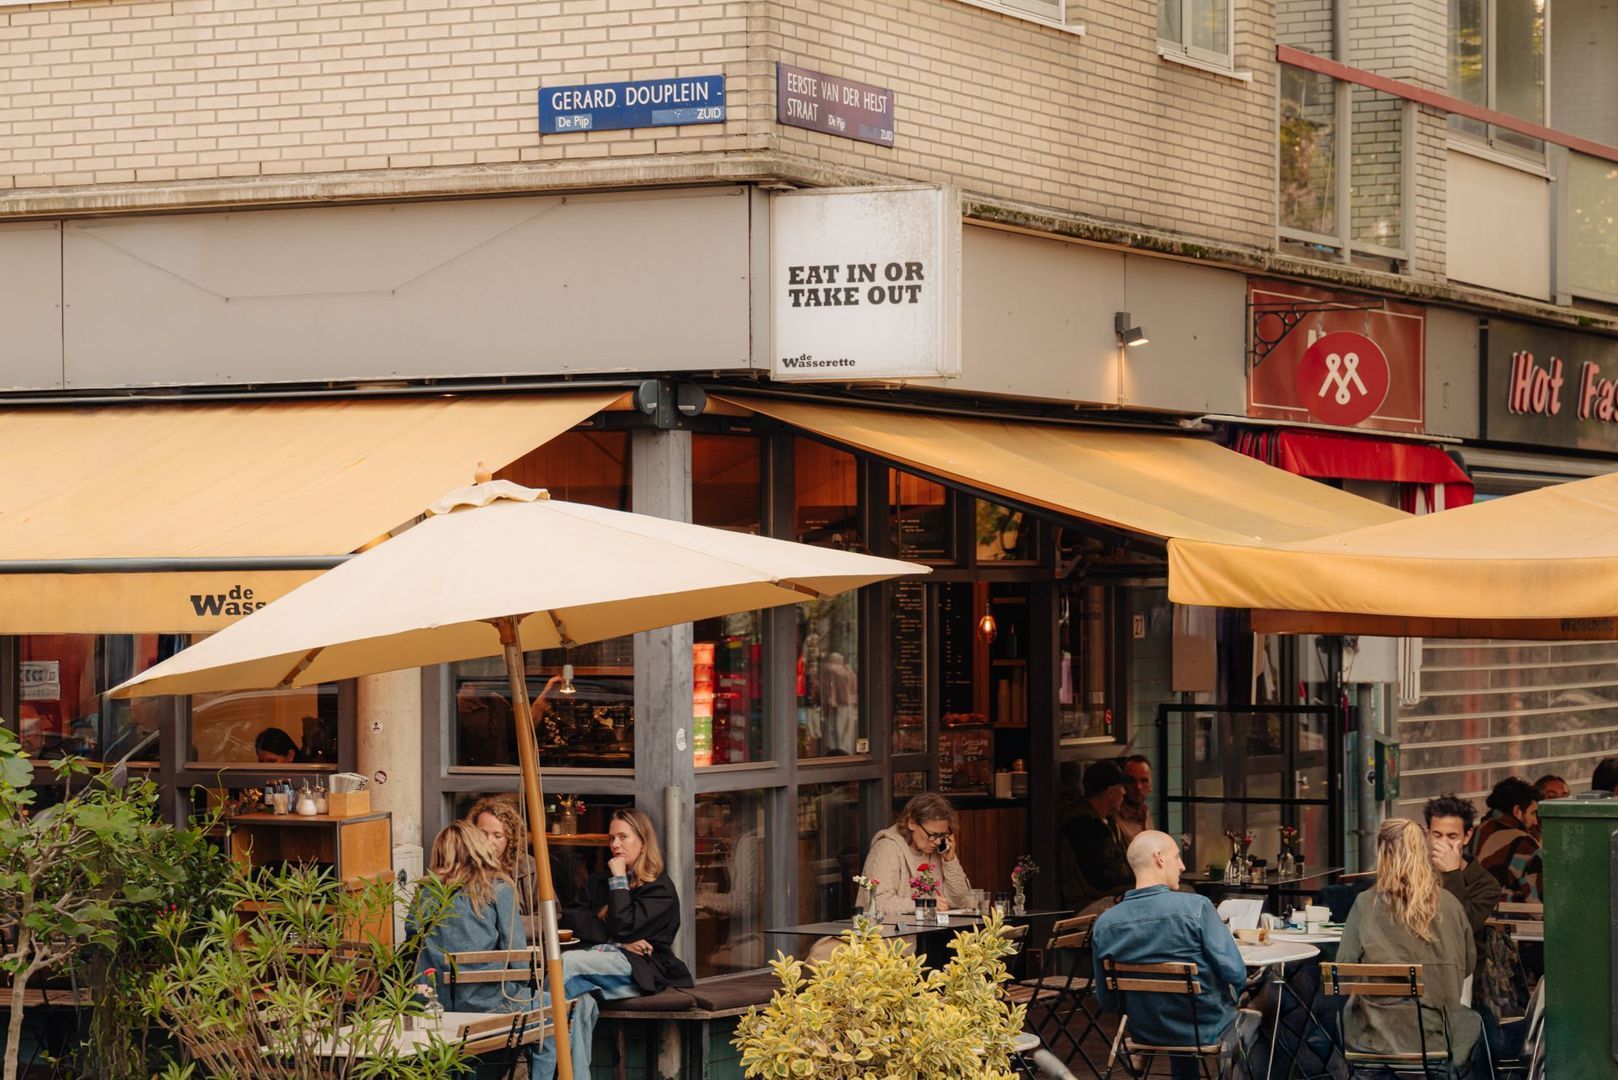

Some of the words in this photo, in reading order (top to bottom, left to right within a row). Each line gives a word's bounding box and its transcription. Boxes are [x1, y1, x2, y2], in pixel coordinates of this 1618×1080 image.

[551, 88, 617, 111] GERARD
[625, 81, 709, 106] DOUPLEIN
[787, 72, 818, 98] EERSTE
[820, 81, 839, 104] VAN
[843, 86, 861, 108] DER
[863, 91, 888, 115] HELST
[696, 107, 722, 121] ZUID
[787, 97, 819, 123] STRAAT
[558, 116, 572, 128] De
[573, 115, 590, 130] Pijp
[828, 114, 836, 127] De
[880, 128, 894, 142] ZUID
[788, 264, 840, 285] EAT
[846, 263, 877, 283] IN
[884, 261, 925, 282] OR
[788, 286, 860, 308] TAKE
[867, 284, 922, 305] OUT
[782, 358, 856, 369] Wasserette
[799, 353, 812, 361] de
[1508, 350, 1565, 417] Hot
[228, 584, 254, 600] de
